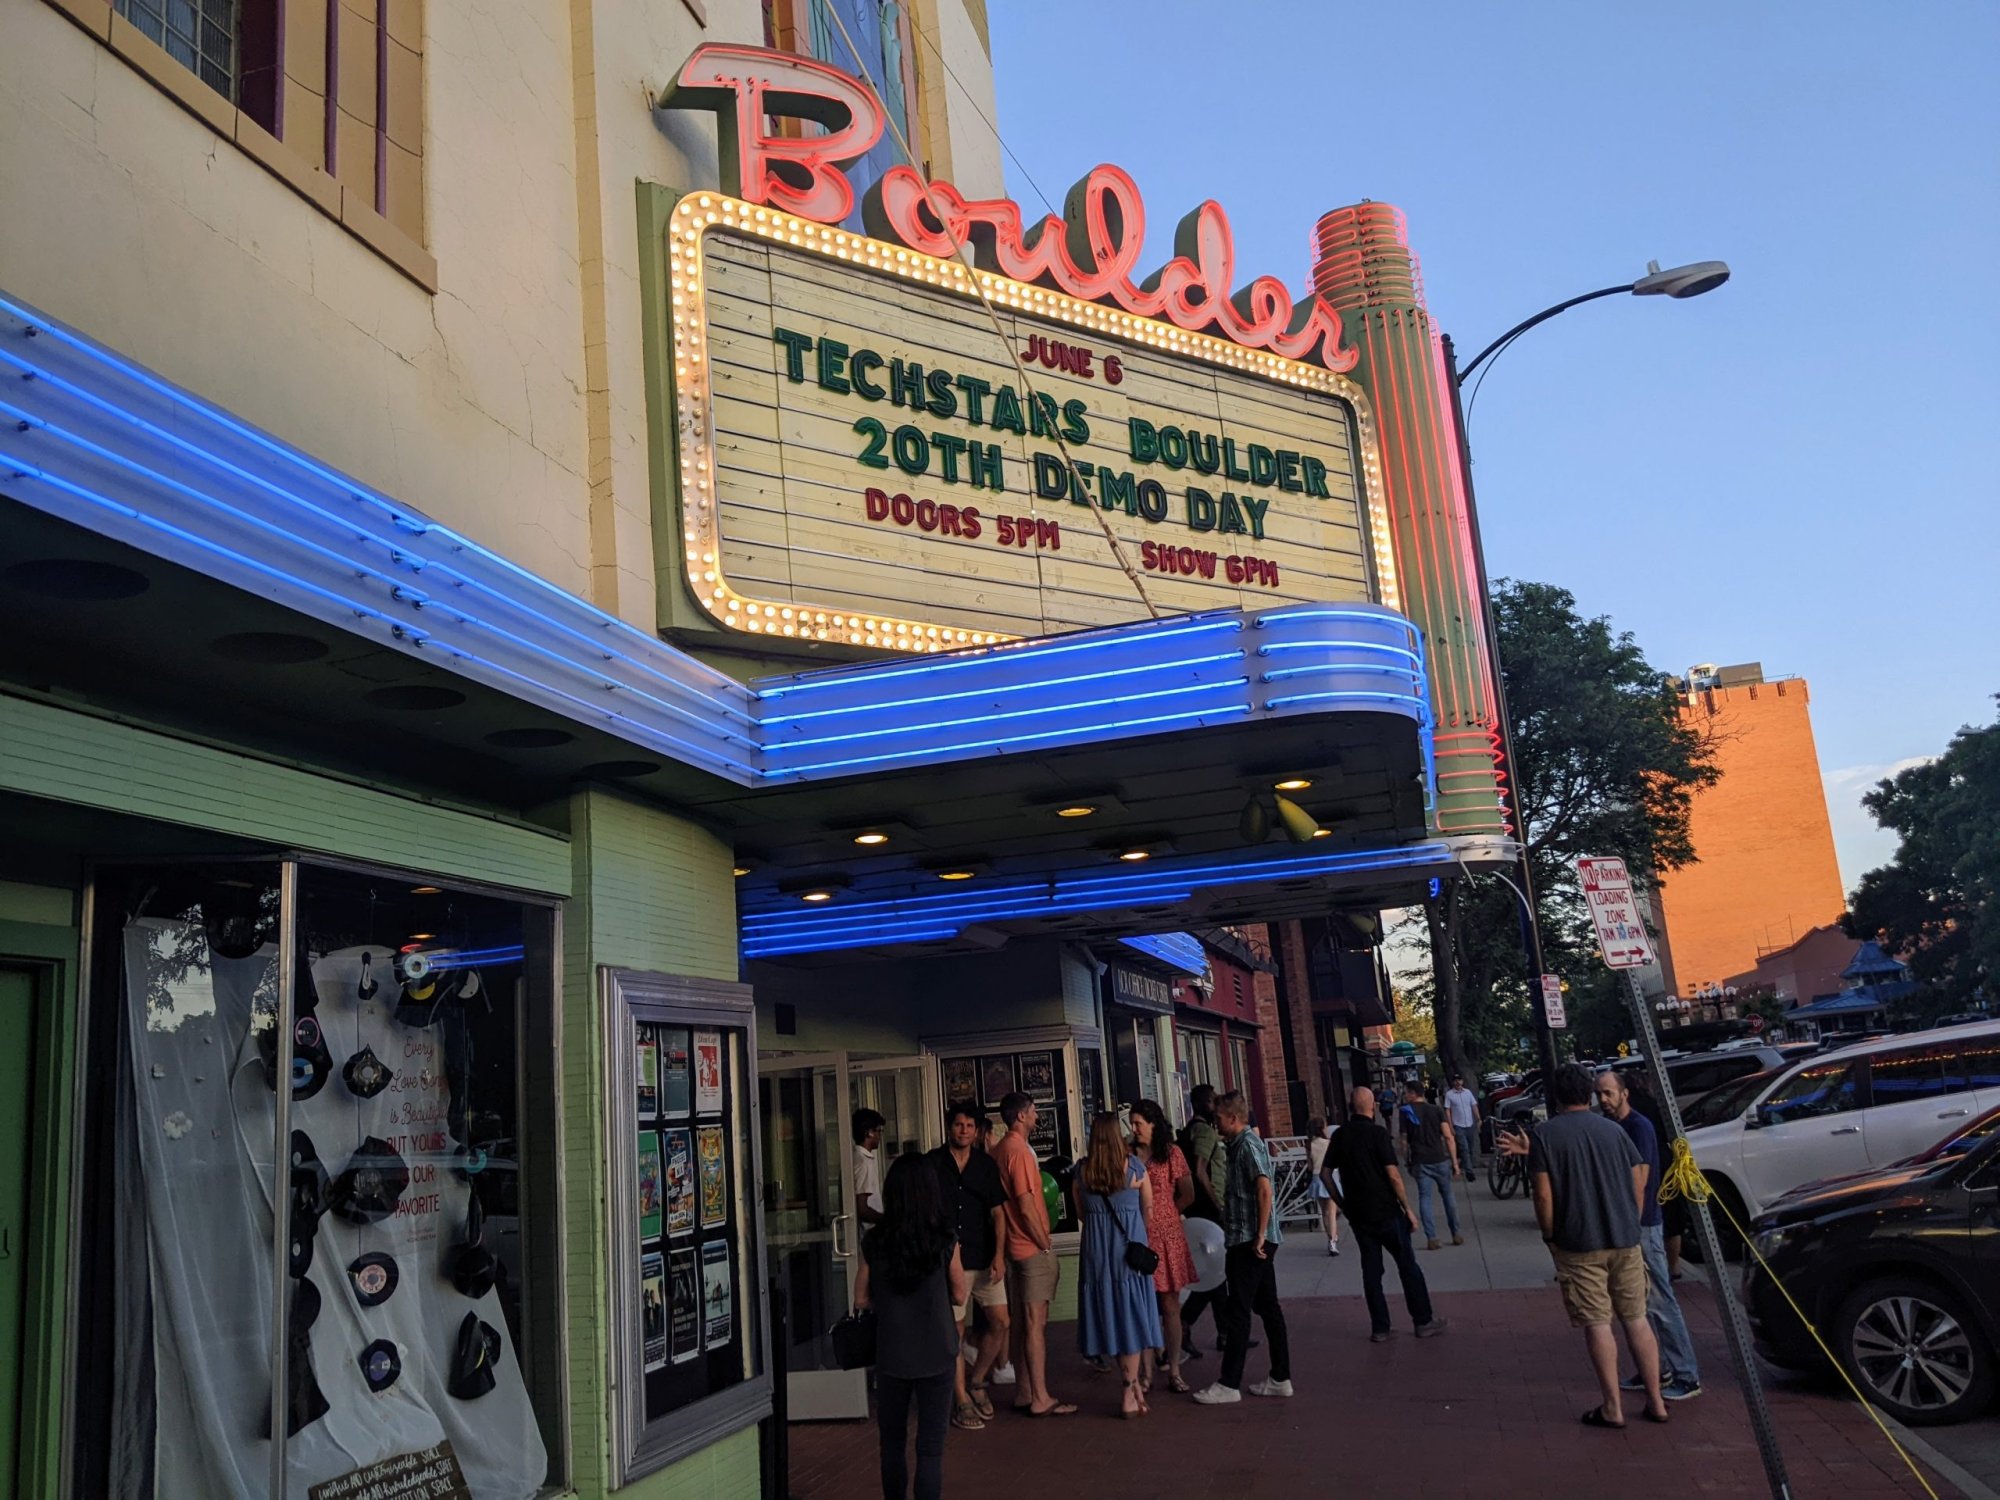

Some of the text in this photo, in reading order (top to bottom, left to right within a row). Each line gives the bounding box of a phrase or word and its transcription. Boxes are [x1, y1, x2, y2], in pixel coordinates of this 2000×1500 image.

[677, 44, 1359, 373] Boulder
[1021, 334, 1123, 386] JUNE 6
[774, 326, 1329, 500] TECHSTARS BOULDER
[852, 415, 1269, 540] 20TH DEMO DAY
[864, 487, 1060, 550] DOORS 5PM
[1141, 540, 1279, 588] SHOW 6PM
[1580, 866, 1625, 886] NO PARKING
[1593, 891, 1628, 906] LOADING
[1605, 910, 1628, 924] ZONE
[1601, 927, 1616, 941] 7AM
[1628, 926, 1642, 940] 6PM
[404, 1035, 435, 1062] Every
[390, 1068, 418, 1093] Love
[390, 1107, 399, 1125] is
[386, 1136, 407, 1155] BUT
[413, 1164, 435, 1184] OUR
[393, 1194, 440, 1219] FAVORITE
